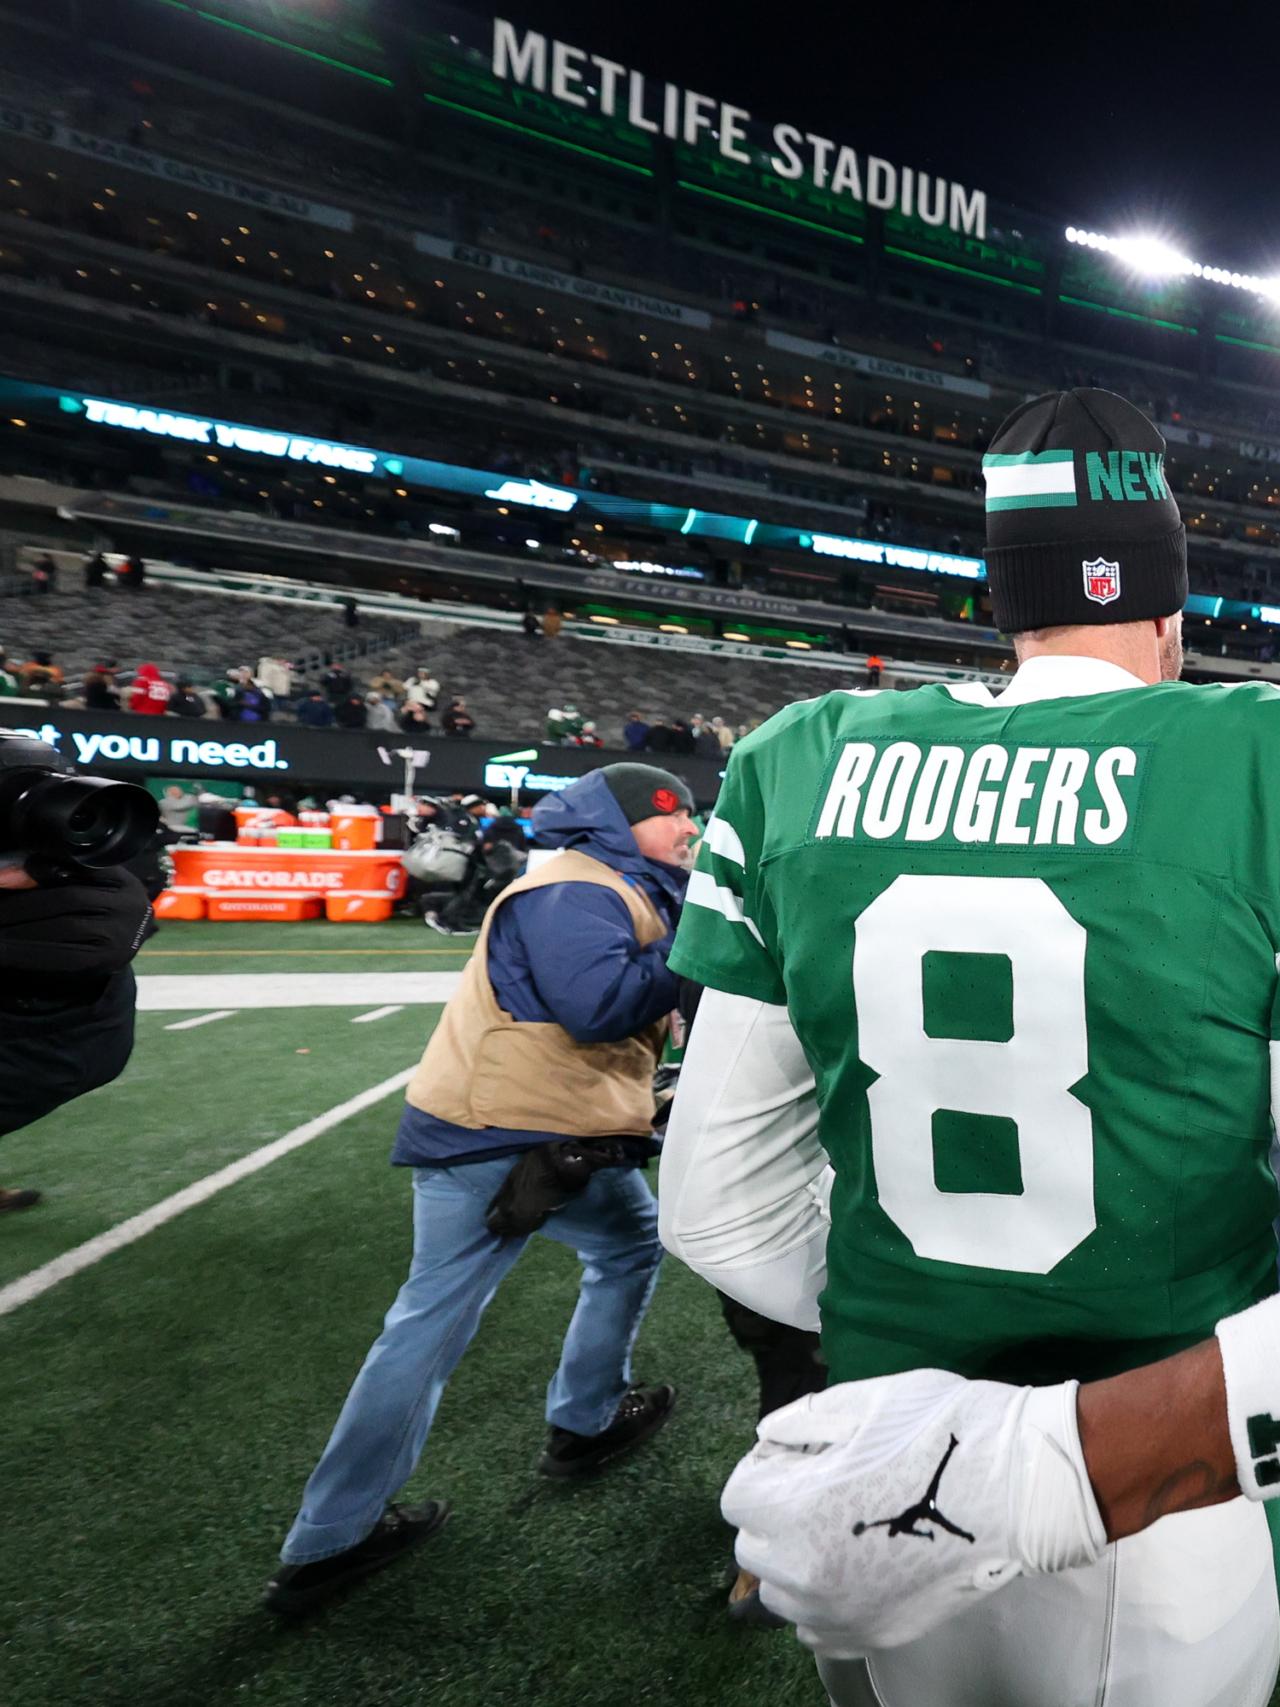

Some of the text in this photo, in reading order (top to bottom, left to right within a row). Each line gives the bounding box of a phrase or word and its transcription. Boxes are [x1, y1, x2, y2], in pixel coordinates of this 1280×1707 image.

[493, 17, 986, 239] METLIFE STADIUM
[1086, 449, 1168, 502] NEW
[1088, 577, 1116, 598] NFL
[72, 732, 160, 764] you
[170, 738, 289, 770] need.
[485, 764, 530, 789] EY
[814, 740, 1137, 846] RODGERS
[202, 869, 344, 889] GATORADE
[852, 874, 1097, 1275] 8
